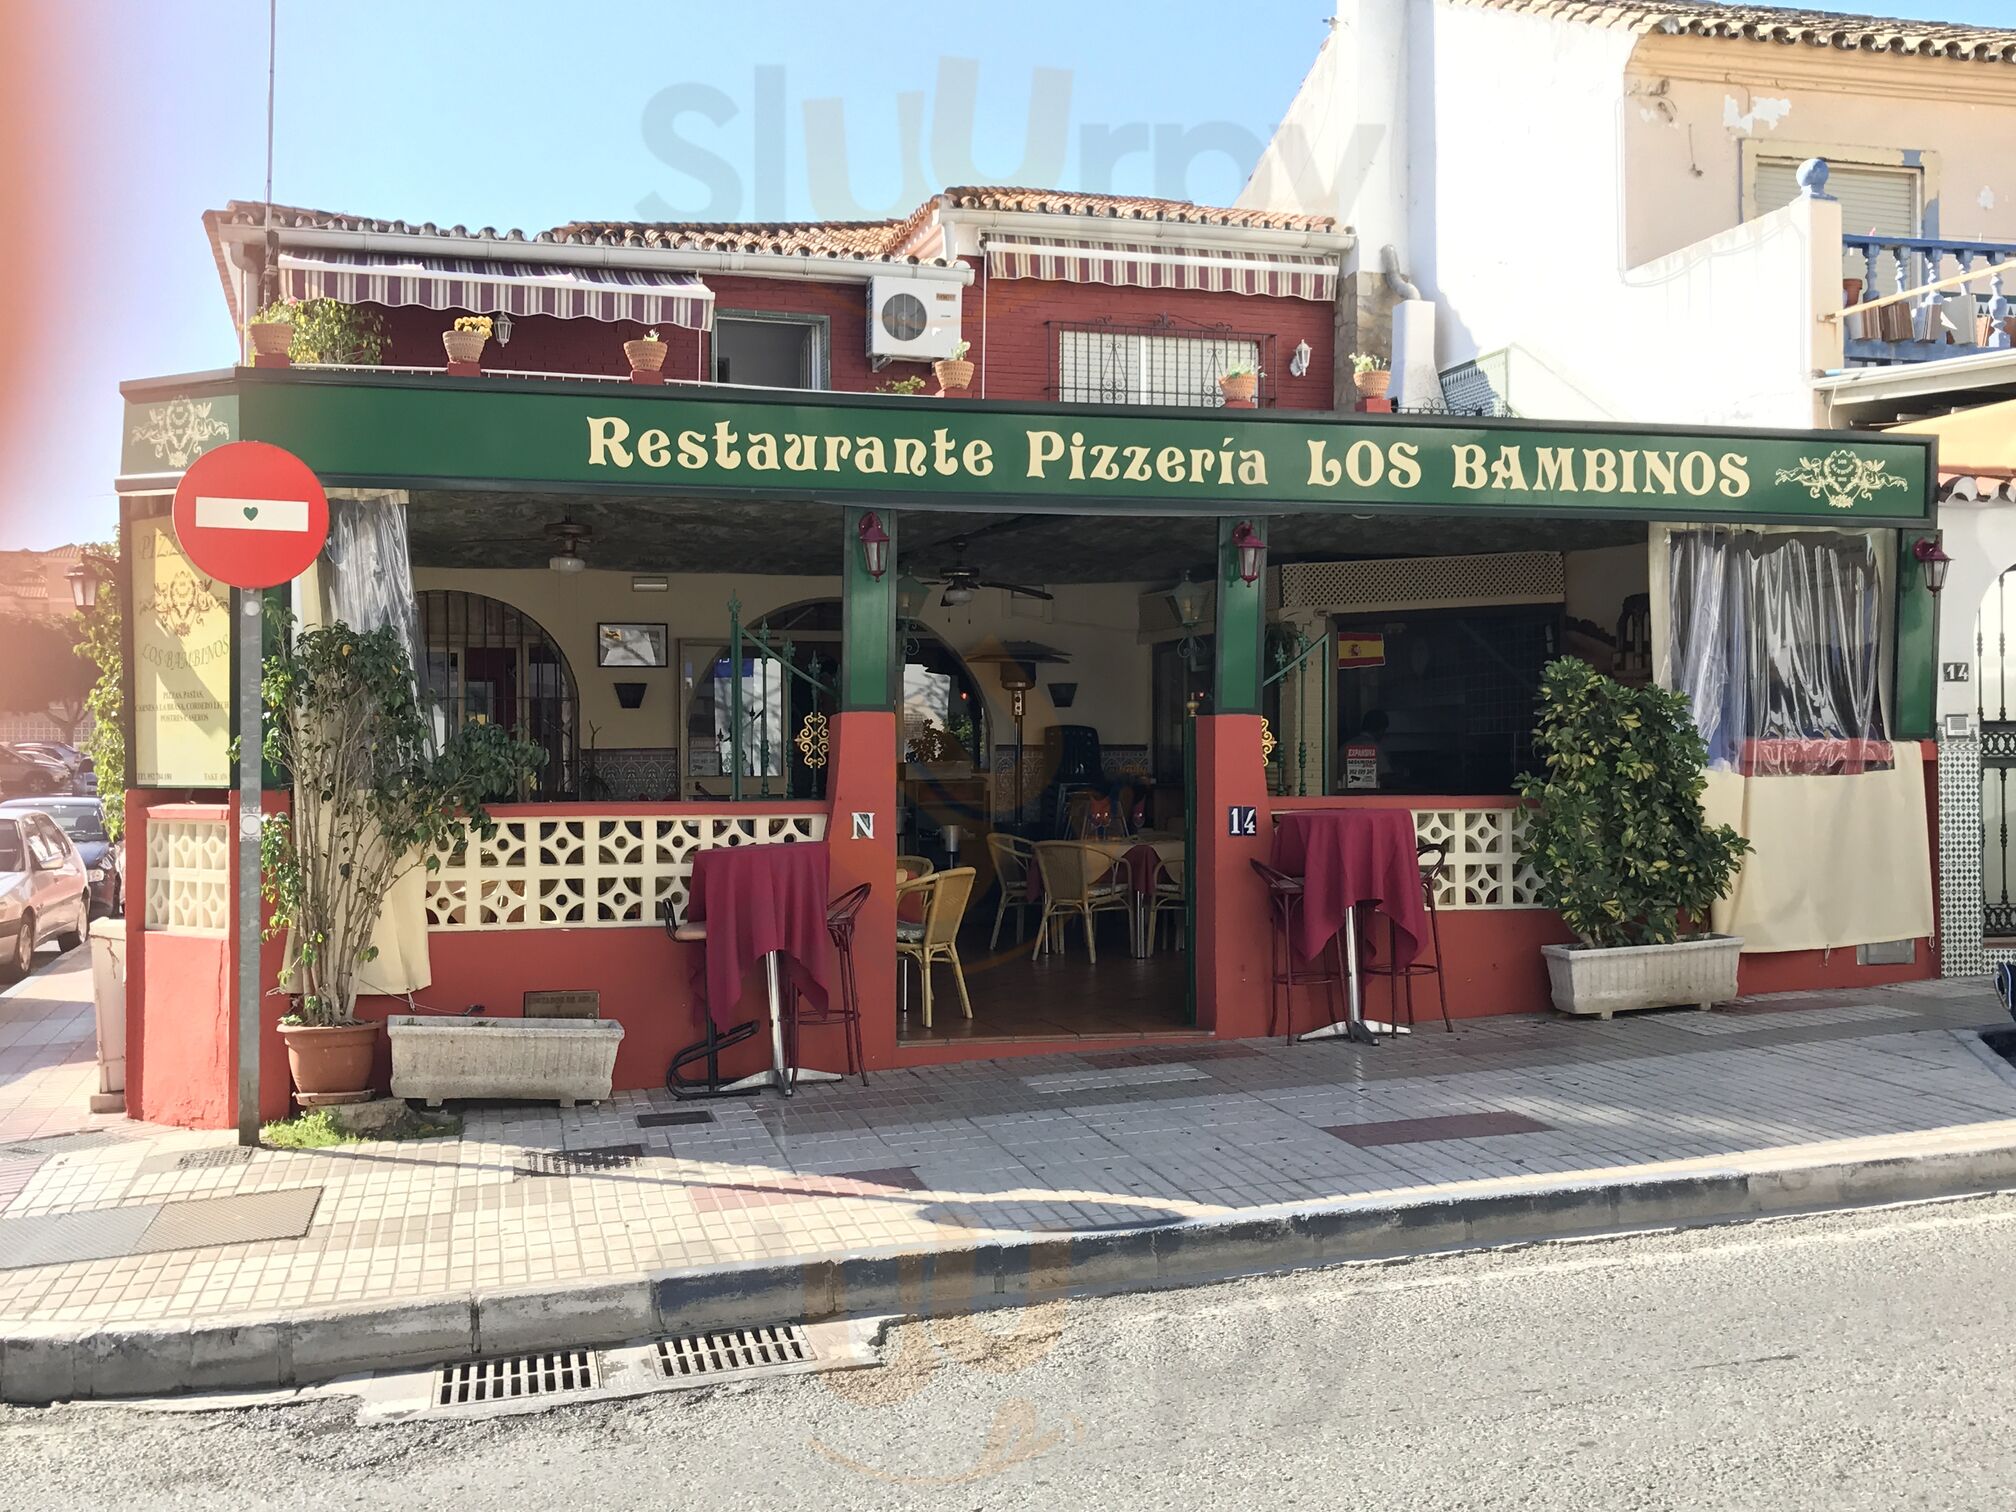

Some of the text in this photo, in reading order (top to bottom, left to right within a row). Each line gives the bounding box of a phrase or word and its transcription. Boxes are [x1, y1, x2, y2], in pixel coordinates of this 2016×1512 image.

[586, 416, 1751, 498] Restaurante Pizzería LOS BAMBINOS
[143, 634, 229, 671] LOS BAMBINOS
[1946, 664, 1969, 680] 14
[850, 812, 875, 840] N
[1230, 807, 1256, 835] 14
